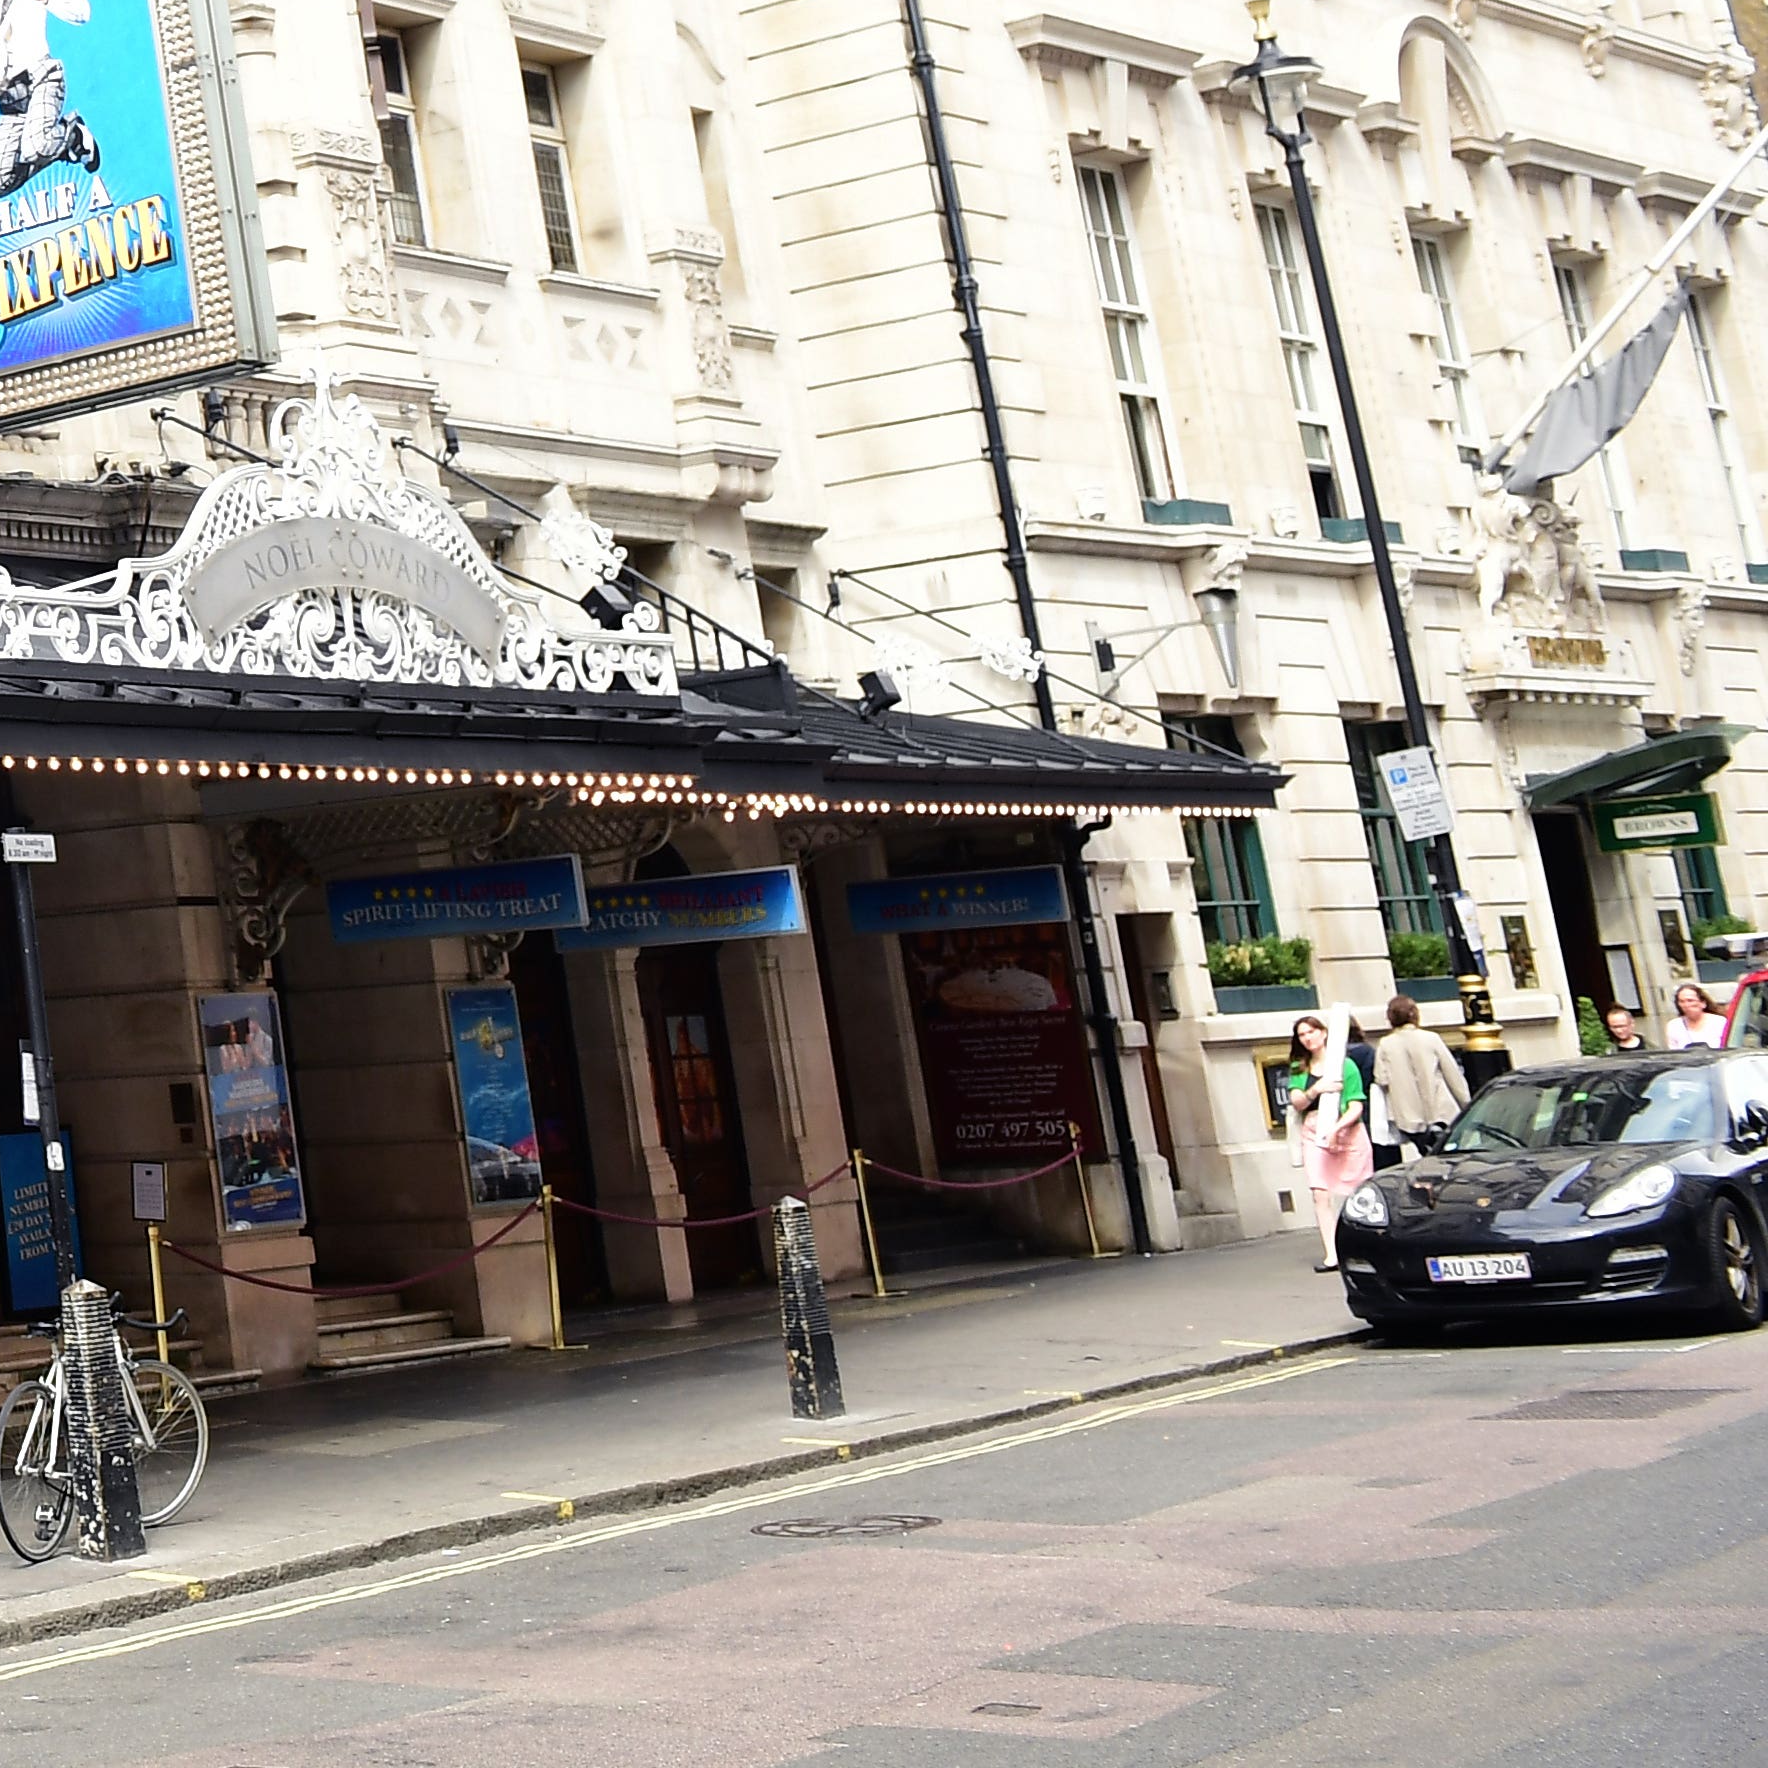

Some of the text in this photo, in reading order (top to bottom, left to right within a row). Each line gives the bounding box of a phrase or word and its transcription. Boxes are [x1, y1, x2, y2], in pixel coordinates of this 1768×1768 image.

[88, 175, 114, 213] A
[243, 533, 451, 604] NOËL COWARD
[658, 885, 764, 908] BRILLIANT
[342, 892, 562, 928] SPIRIT-LIFTING TREAT
[668, 904, 768, 929] NUMBERS
[880, 897, 1031, 920] WHAT A WINNER!
[956, 1119, 1068, 1140] 0207 497 505
[20, 1242, 50, 1261] FROM
[1443, 1259, 1526, 1277] AU 13 204
